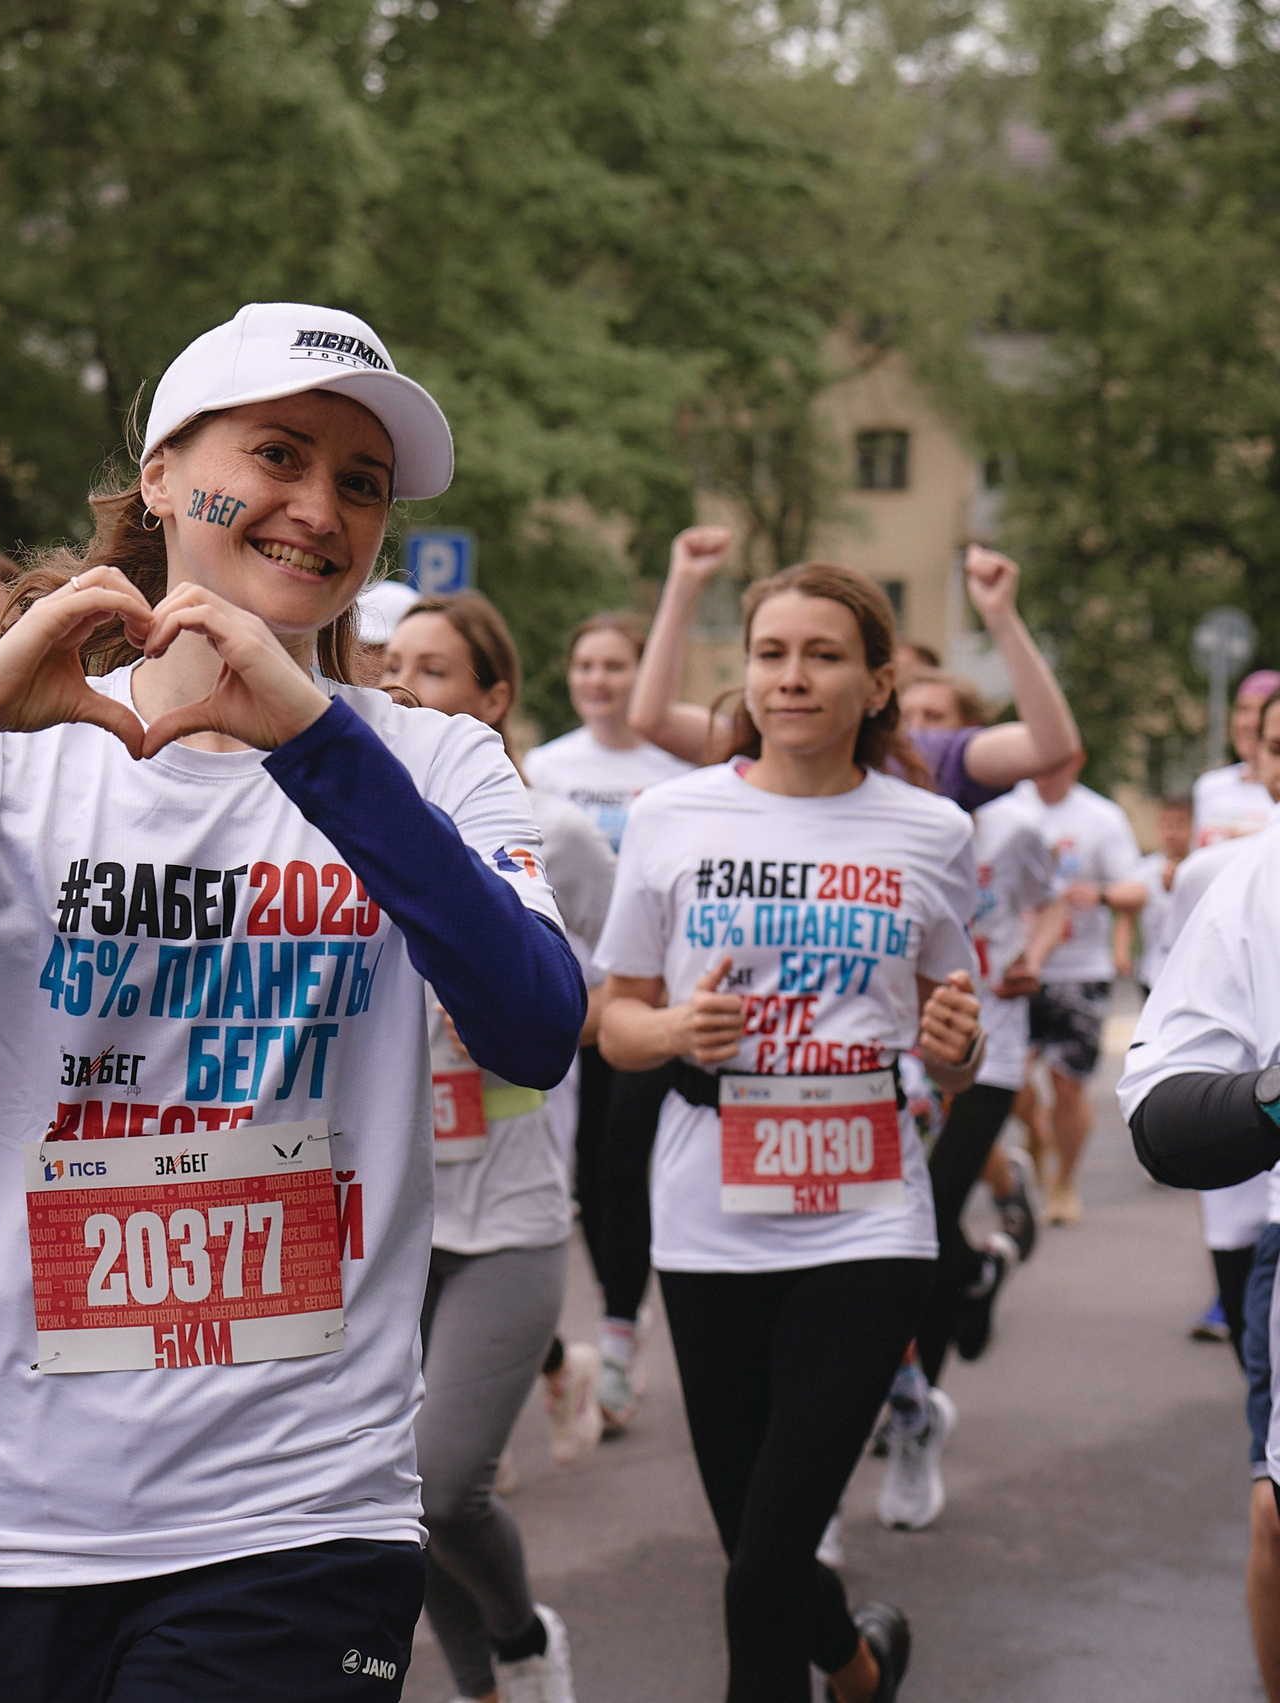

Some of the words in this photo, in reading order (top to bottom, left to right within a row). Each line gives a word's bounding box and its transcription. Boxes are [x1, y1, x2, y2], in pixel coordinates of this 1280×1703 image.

[307, 351, 368, 369] FOOT
[187, 488, 247, 529] ЗАБЕГ
[696, 858, 903, 908] #ЗАБЕГ2025
[57, 858, 380, 940] #ЗАБЕГ2025
[686, 902, 744, 950] 45%
[753, 903, 913, 959] ПЛАНЕТЫ
[39, 935, 142, 1019] 45%
[149, 941, 384, 1019] ПЛАНЕТЫ
[778, 950, 880, 996] БЕГУТ
[741, 993, 819, 1036] ЕСТЕ
[61, 1053, 146, 1087] ЗАБЕГ
[184, 1022, 338, 1102] БЕГУТ
[754, 1116, 873, 1177] 20130
[70, 1161, 107, 1177] ПСБ
[155, 1153, 209, 1176] ЗАБЕГ
[178, 1183, 204, 1199] ПОКА
[204, 1182, 222, 1196] ВСЕ
[222, 1179, 246, 1195] СПЯТ
[265, 1175, 292, 1190] ЛЮБИ
[292, 1173, 308, 1188] БЕГ
[308, 1172, 315, 1186] В
[31, 1191, 88, 1206] КИЛОМЕТРЫ
[794, 1184, 839, 1213] 5КМ
[300, 1225, 322, 1241] СПЯТ
[48, 1244, 64, 1258] БЕГ
[65, 1243, 73, 1257] В
[84, 1200, 284, 1306] 20377
[282, 1241, 336, 1260] РЕЗАГРУЗКА
[44, 1261, 75, 1278] ДАВНО
[292, 1260, 332, 1277] СЕРДЦЕМ
[308, 1278, 331, 1293] ПОКА
[199, 1304, 245, 1321] ВЫБЕГАЮ
[245, 1302, 258, 1317] ЗА
[258, 1299, 289, 1315] РАМКИ
[304, 1293, 341, 1310] БЕГОВАЯ
[82, 1312, 116, 1327] СТРЕСС
[116, 1310, 147, 1326] ДАВНО
[147, 1308, 182, 1324] ОТСТАЛ
[153, 1322, 233, 1368] 5КМ
[362, 1656, 397, 1681] JAKO
